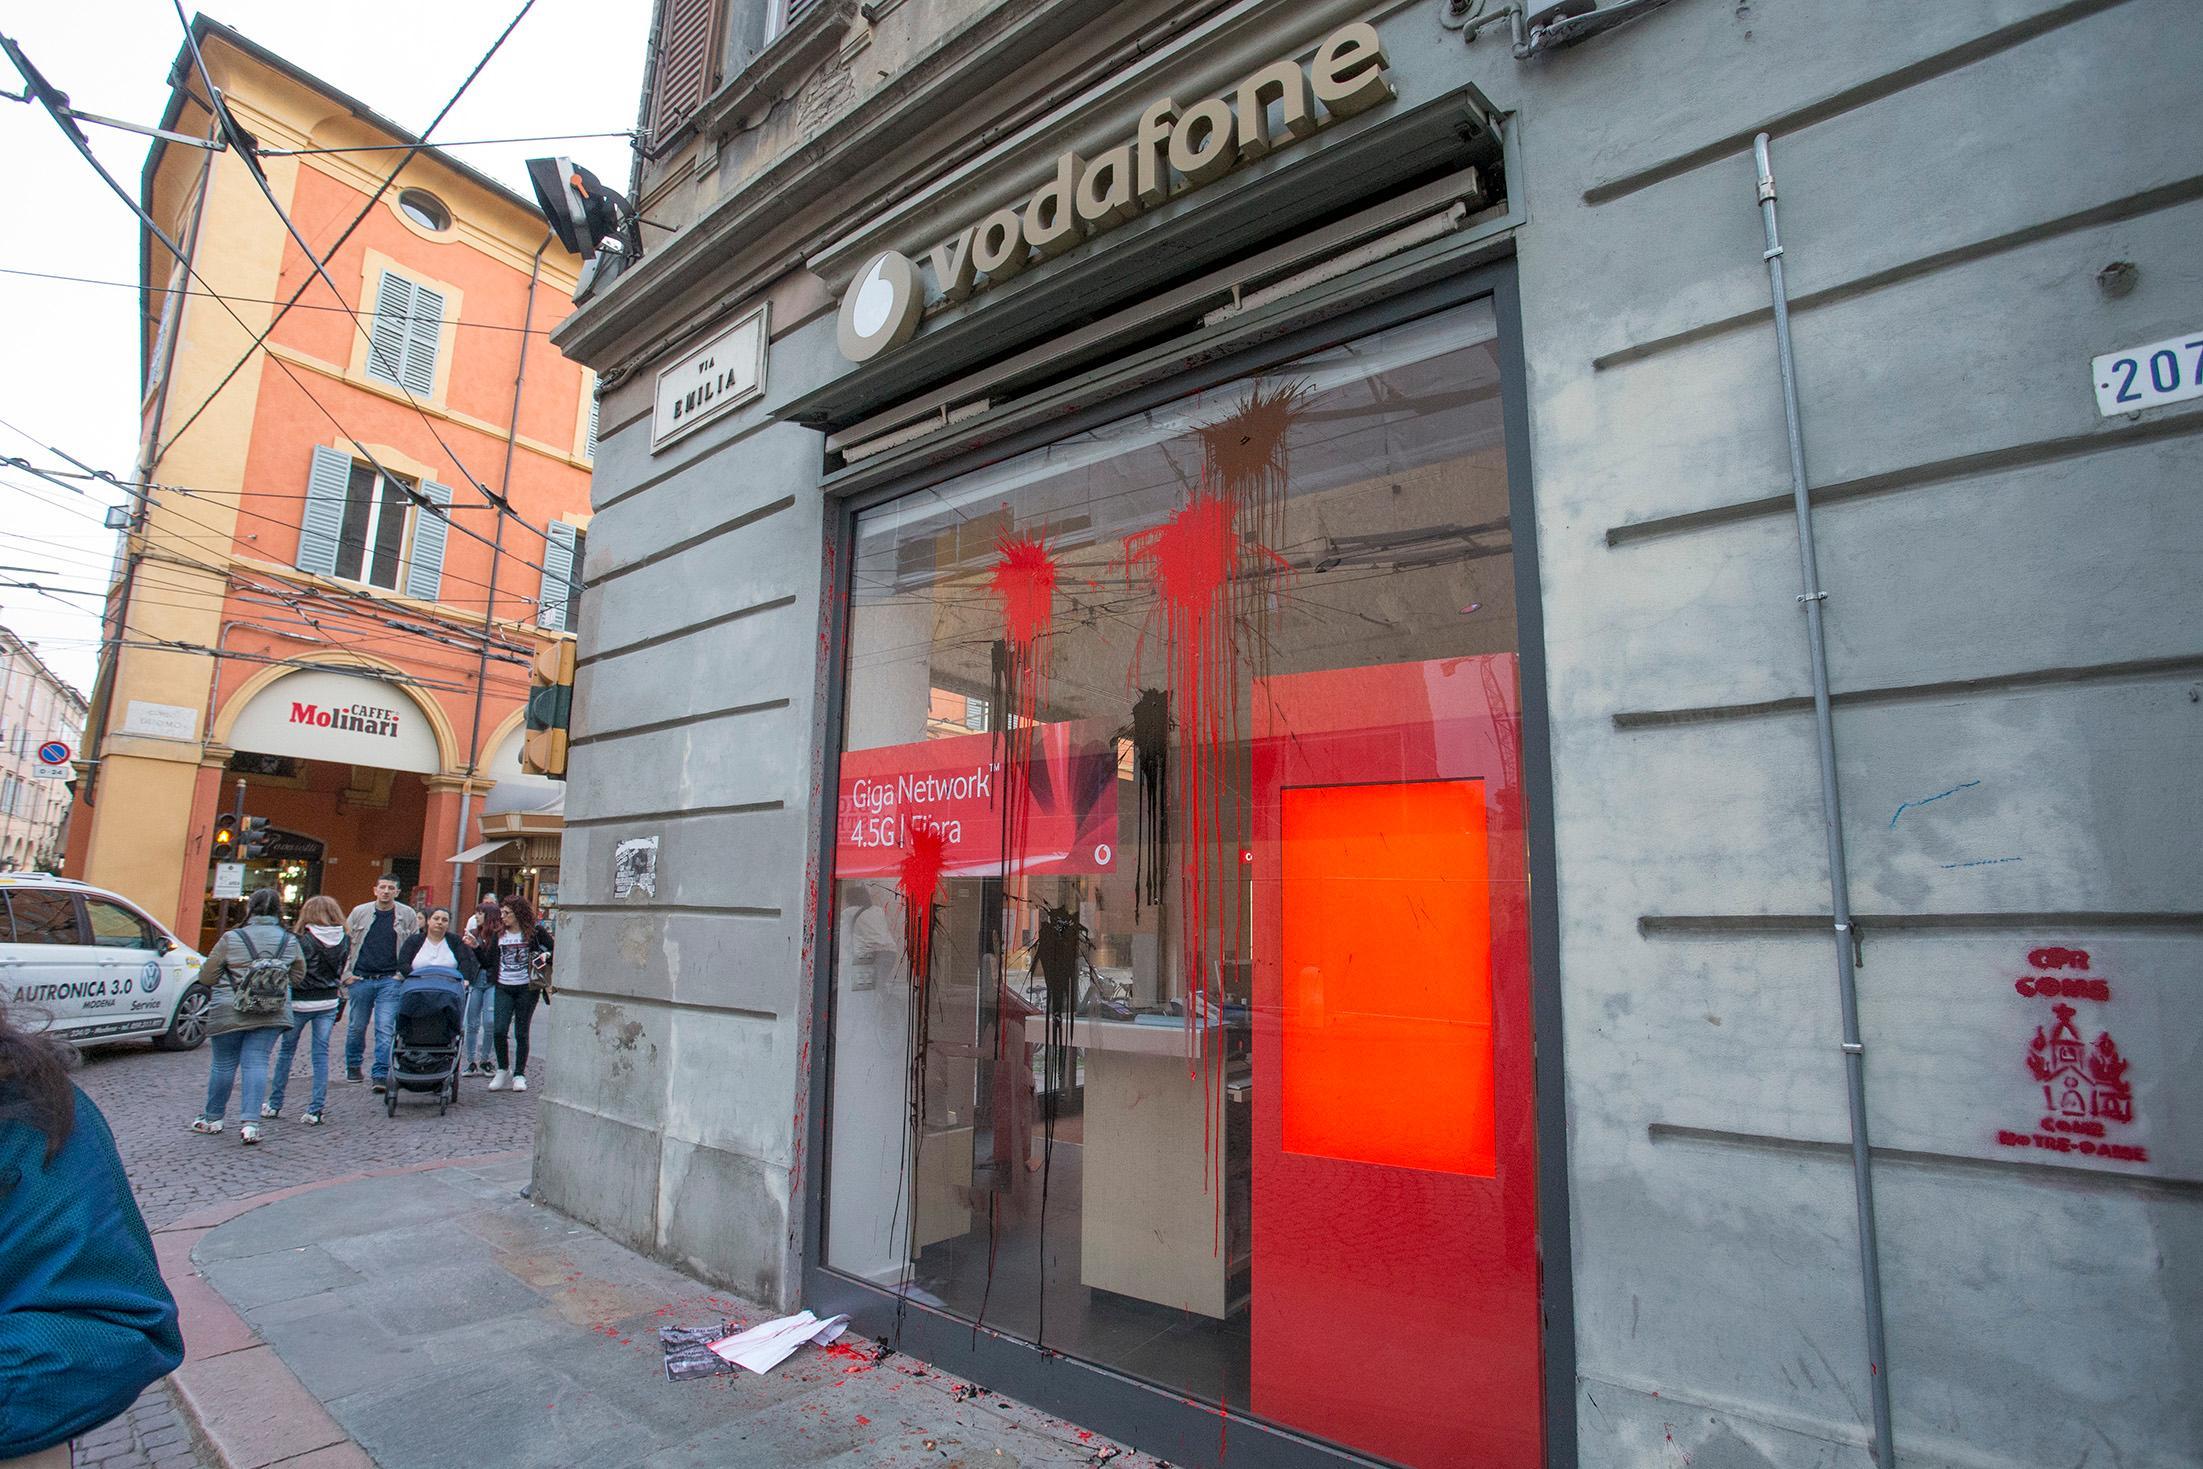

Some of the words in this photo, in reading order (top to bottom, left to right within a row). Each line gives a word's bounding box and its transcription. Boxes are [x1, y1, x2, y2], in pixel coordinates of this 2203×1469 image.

[928, 21, 1391, 300] vodafone
[698, 356, 715, 374] VIA
[673, 368, 736, 420] EMILIA
[289, 702, 399, 738] Molinari
[852, 778, 895, 814] Giga
[851, 816, 895, 848] 4.5G
[13, 981, 106, 1004] AUTRONICA
[111, 978, 133, 996] 3.0
[82, 999, 116, 1010] MODENA
[130, 998, 161, 1011] Service
